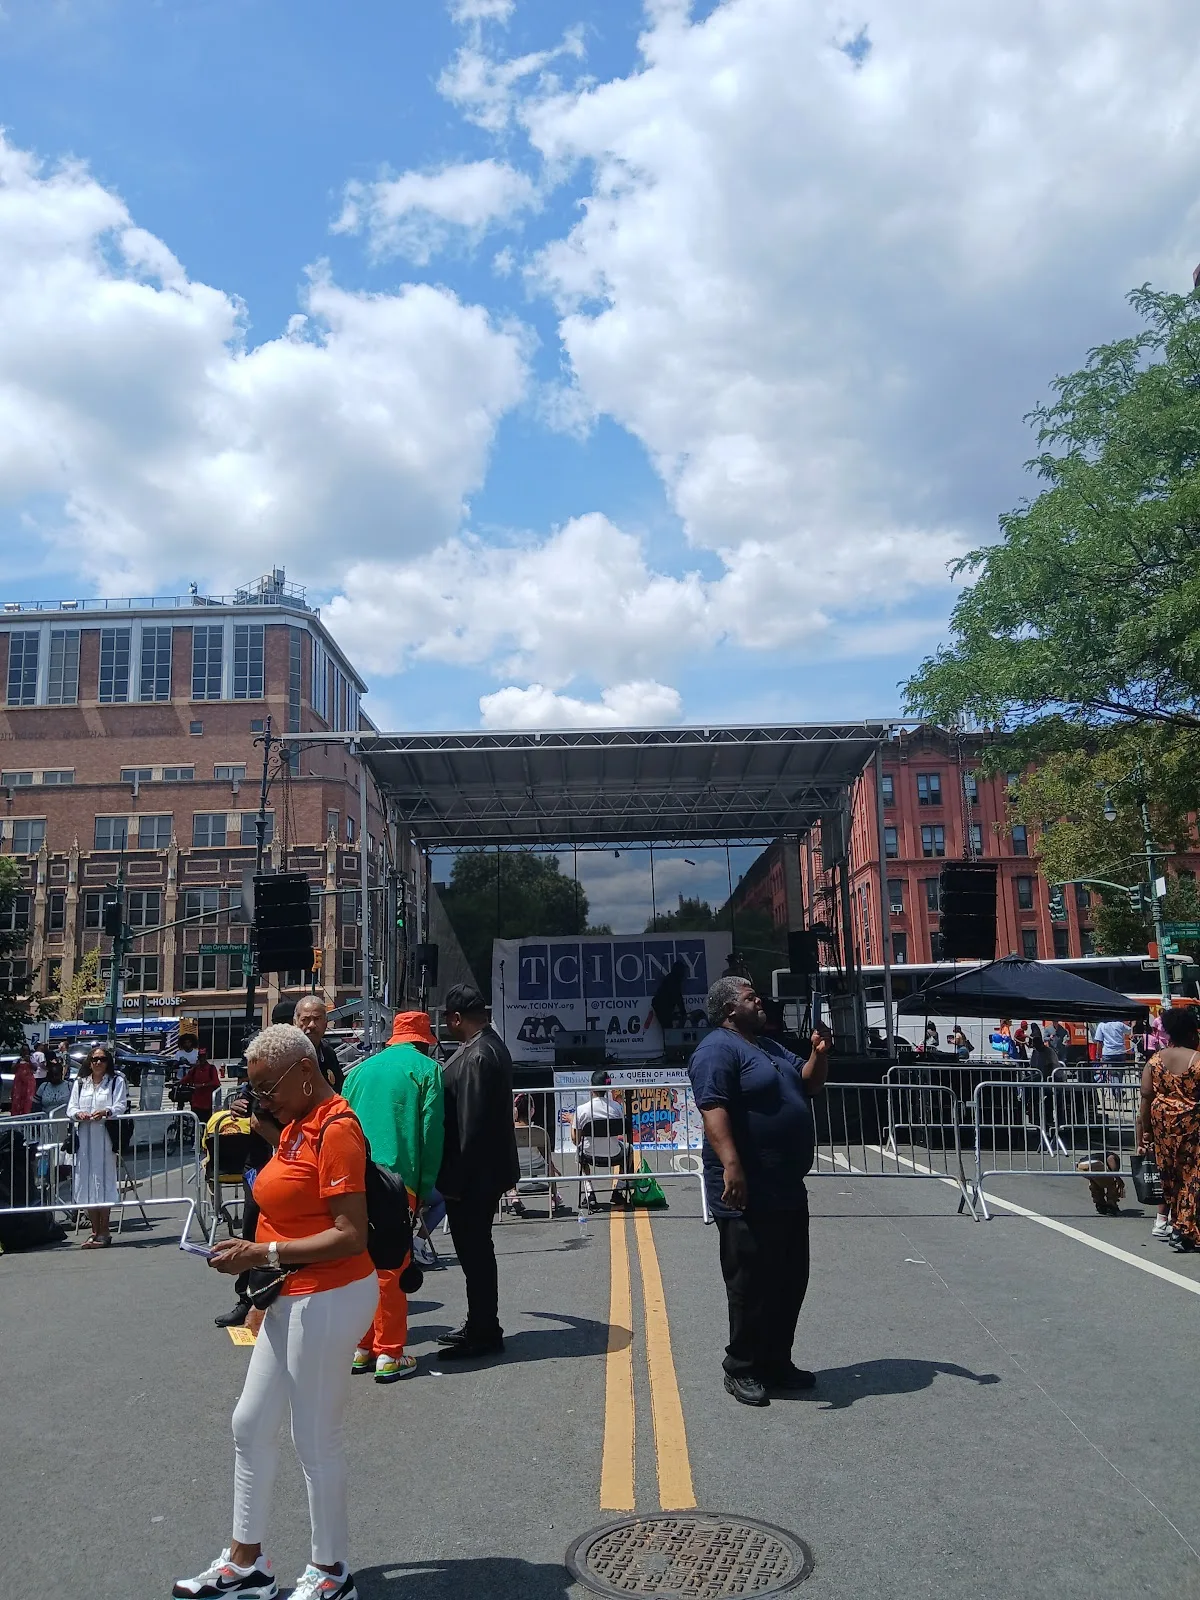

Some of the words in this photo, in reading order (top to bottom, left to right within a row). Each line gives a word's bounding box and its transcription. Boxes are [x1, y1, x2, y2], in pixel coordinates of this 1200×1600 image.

[522, 952, 704, 985] TCIONY
[153, 997, 180, 1007] HOUSE
[506, 1002, 575, 1010] www.TCIONY.org
[590, 1000, 639, 1010] @TCIONY
[685, 997, 705, 1005] IONY
[555, 1076, 590, 1084] CHRISTIAN
[626, 1071, 652, 1079] QUEEN
[666, 1070, 688, 1078] HARLE
[631, 1087, 668, 1100] UMMER
[625, 1096, 671, 1114] OUTH
[632, 1110, 675, 1124] PLOSION
